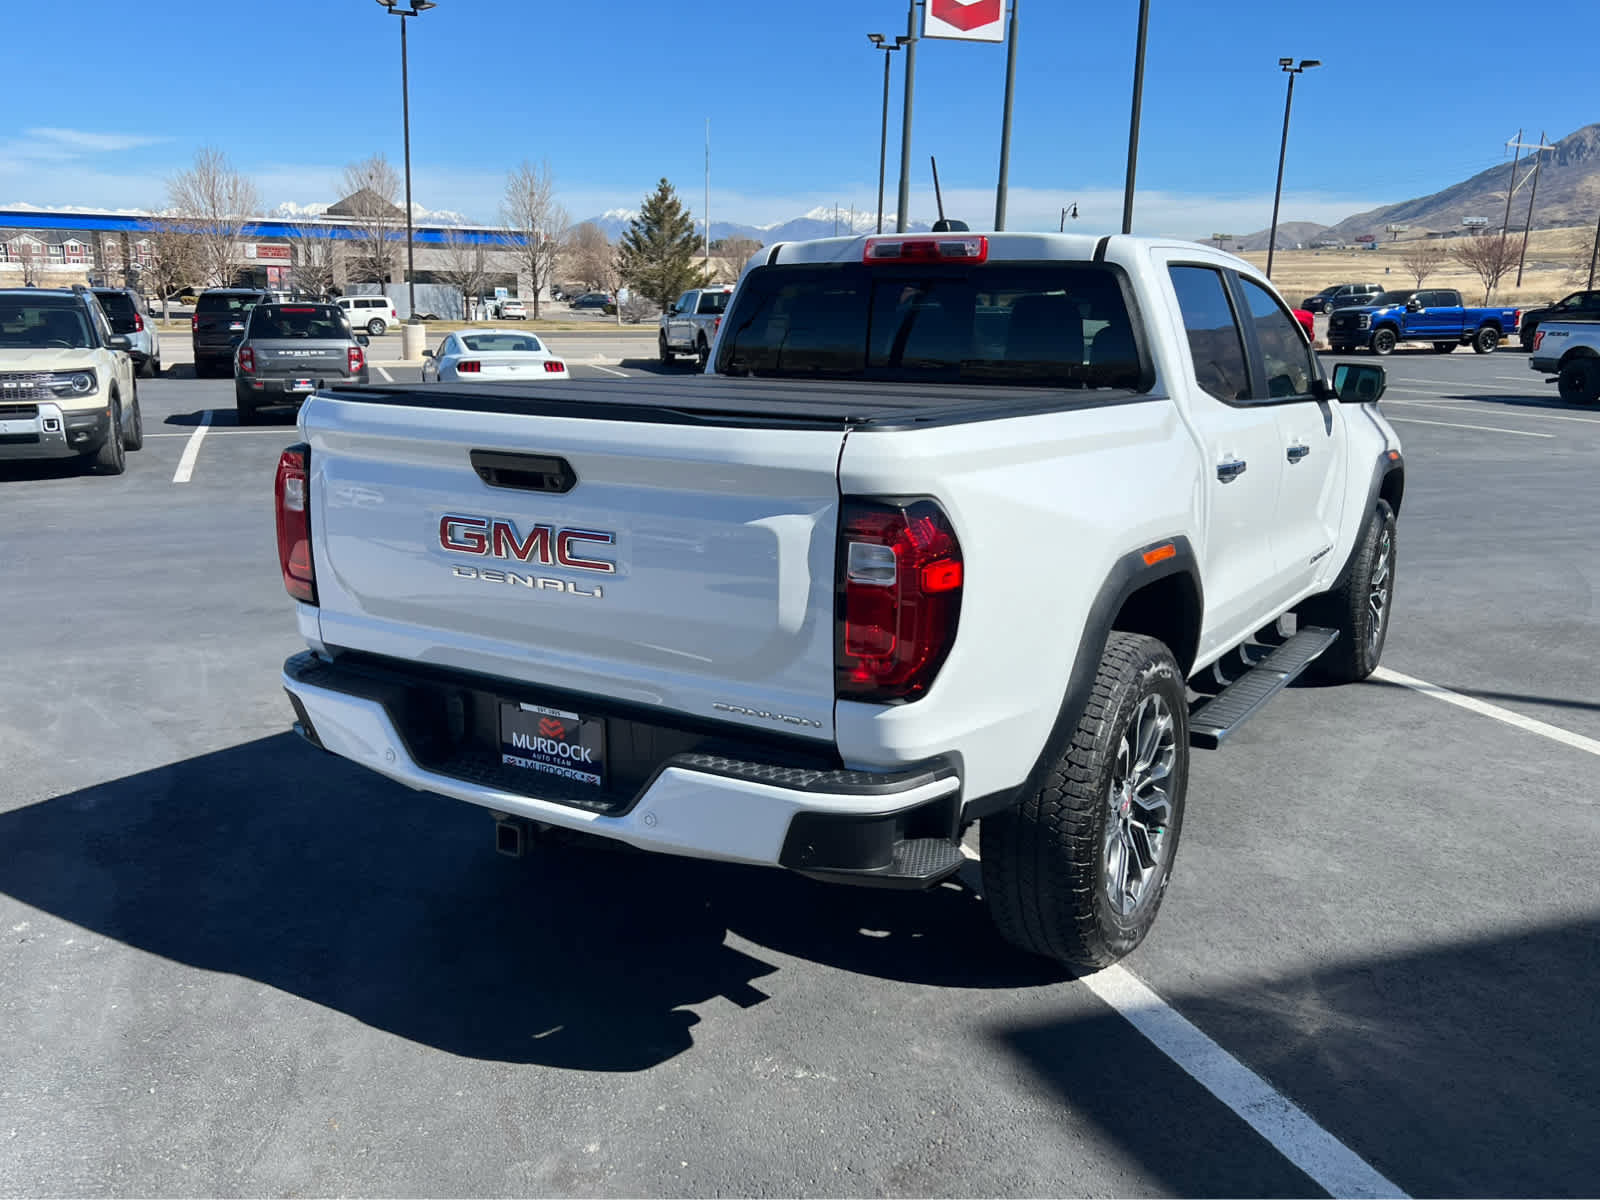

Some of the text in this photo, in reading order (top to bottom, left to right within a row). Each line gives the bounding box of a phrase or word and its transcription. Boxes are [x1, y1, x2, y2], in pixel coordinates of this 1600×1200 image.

[439, 513, 616, 573] GMC
[452, 564, 603, 598] DENALI
[512, 732, 592, 764] MURDOCK
[532, 753, 572, 767] AUTO TEAM
